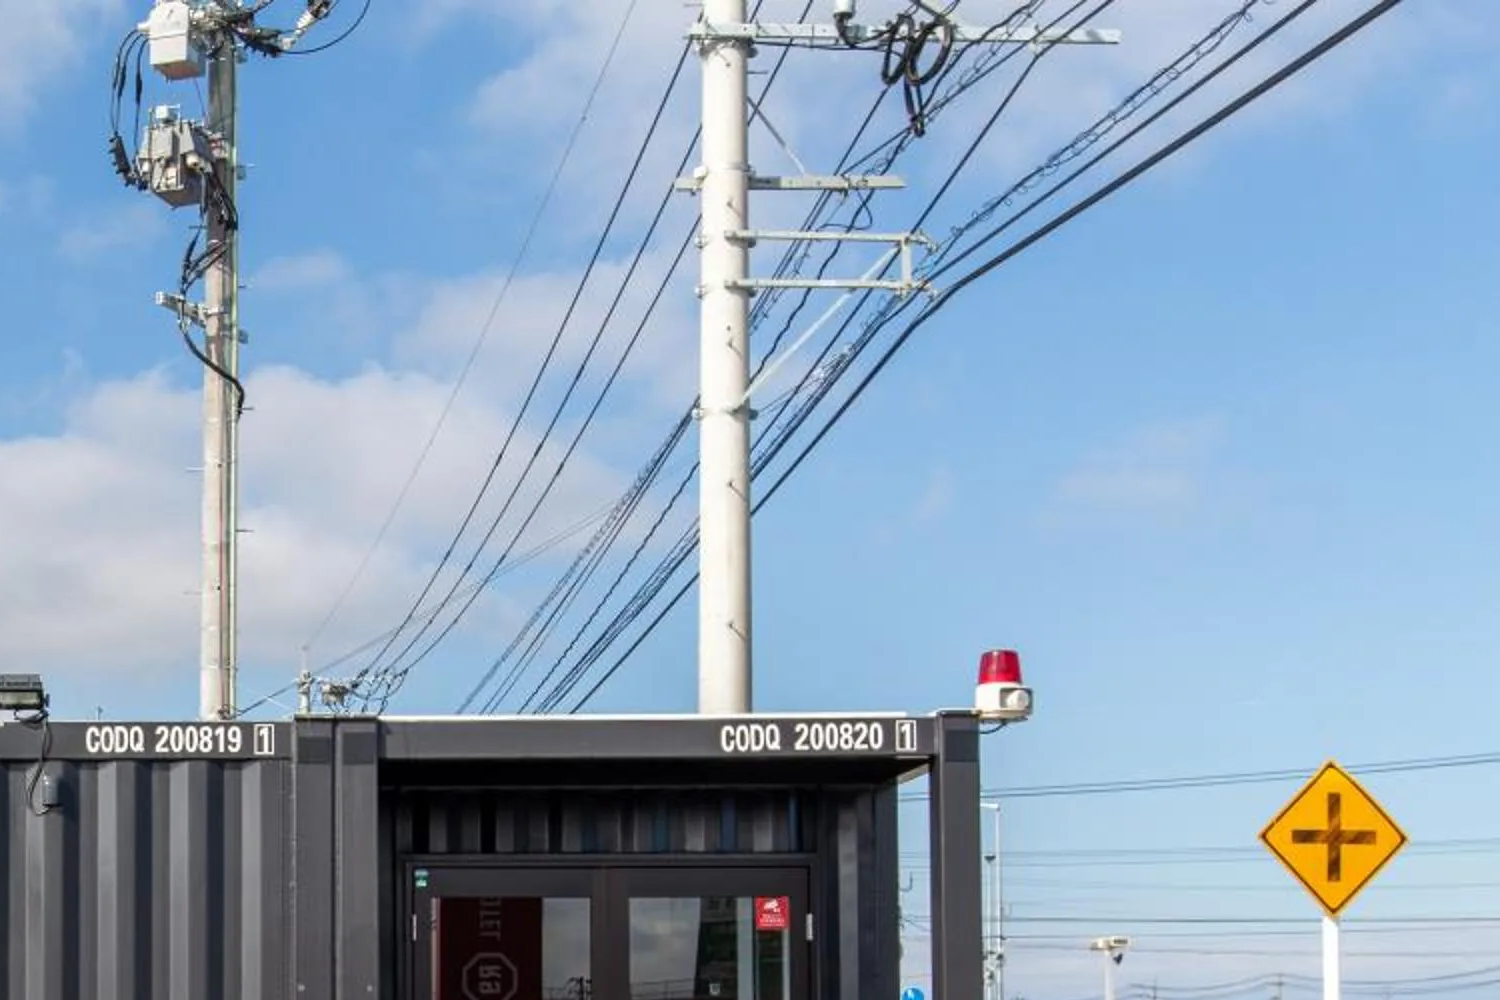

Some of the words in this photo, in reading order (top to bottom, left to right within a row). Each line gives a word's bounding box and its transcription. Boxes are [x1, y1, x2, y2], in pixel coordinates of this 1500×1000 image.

[85, 725, 145, 753] CODQ
[155, 725, 242, 753] 200819
[721, 724, 781, 752] CODQ
[794, 722, 883, 751] 200820
